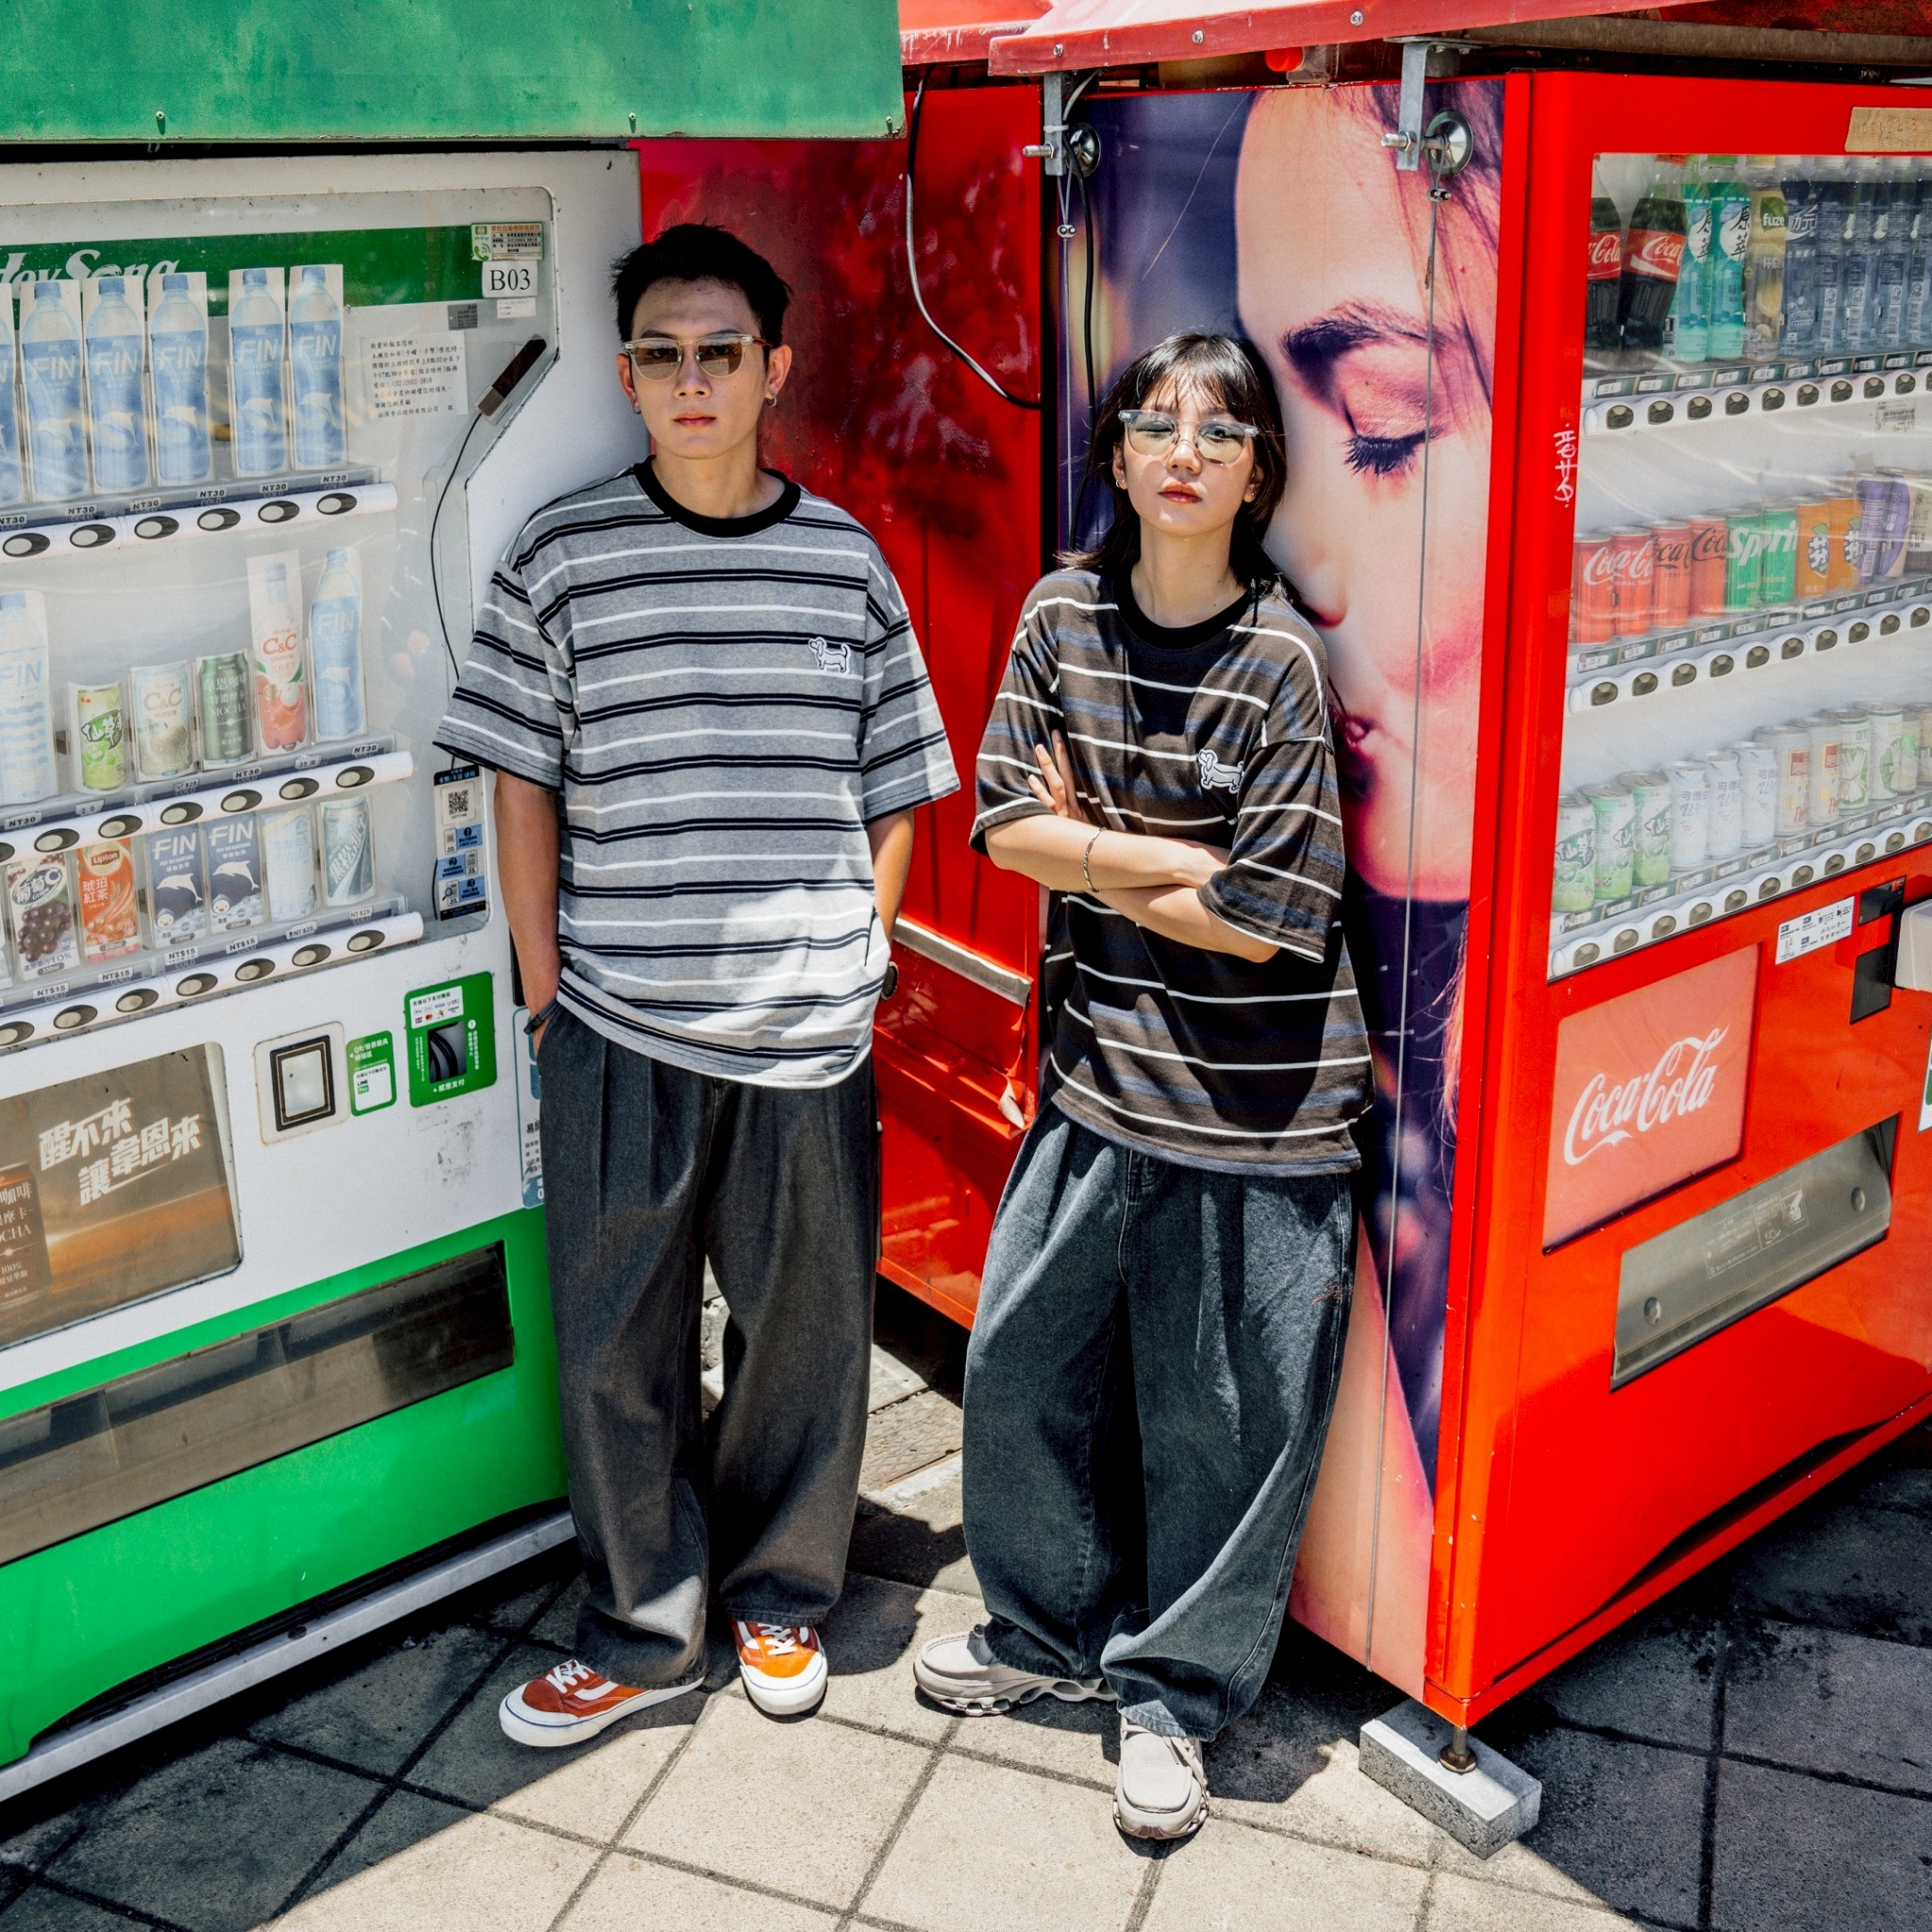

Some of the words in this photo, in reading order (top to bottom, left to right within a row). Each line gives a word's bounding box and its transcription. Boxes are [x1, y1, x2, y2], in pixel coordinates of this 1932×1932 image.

[1762, 212, 1785, 227] fuze
[490, 269, 530, 291] B03
[238, 339, 278, 363] FIN
[297, 335, 337, 358] FIN
[94, 350, 138, 375] FIN
[158, 346, 202, 370] FIN
[33, 356, 75, 379] FIN
[200, 490, 225, 498] NT30
[262, 483, 287, 492] NT30
[68, 507, 95, 515] NT30
[133, 500, 159, 509] NT30
[316, 612, 355, 635] FIN
[262, 633, 297, 655] C&C
[144, 687, 182, 711] C&C
[355, 744, 377, 754] NT30
[236, 768, 260, 778] NT30
[9, 817, 36, 827] NT30
[208, 821, 254, 846] FIN
[152, 832, 197, 859] FIN
[93, 852, 118, 864] Lipton
[82, 877, 108, 892] 琥珀
[83, 890, 108, 905] 紅茶
[229, 938, 256, 951] NT$15
[169, 947, 196, 959] NT$15
[102, 968, 130, 980] NT$15
[38, 985, 66, 996] NT$15
[1563, 1024, 1730, 1166] Coca-Cola
[39, 1097, 133, 1172] 醒不來
[78, 1114, 201, 1208] 讓韋恩來
